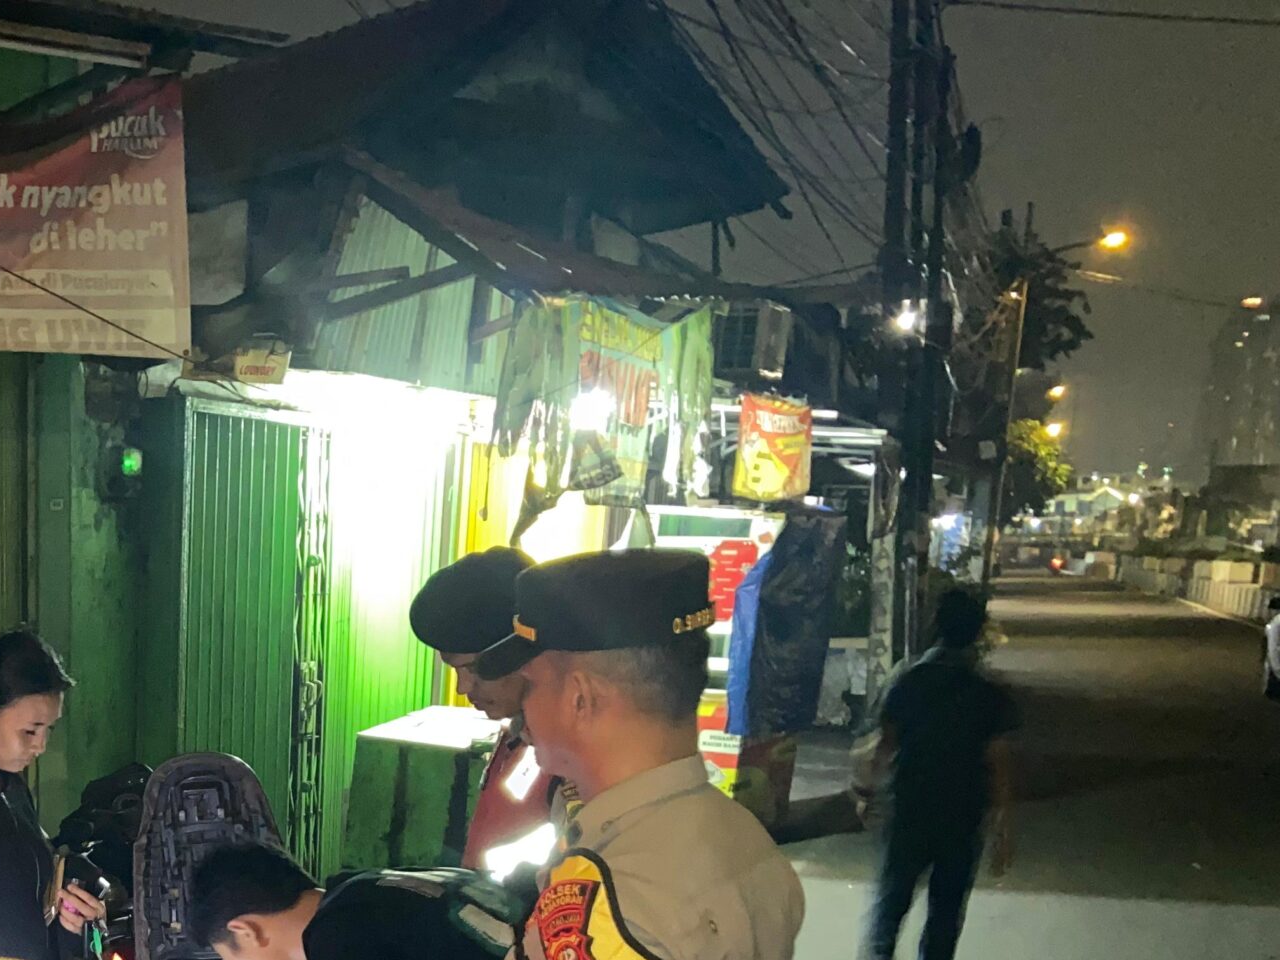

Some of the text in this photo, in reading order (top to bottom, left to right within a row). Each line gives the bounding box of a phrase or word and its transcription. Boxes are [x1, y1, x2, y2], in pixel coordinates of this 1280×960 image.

[90, 104, 167, 153] pucuk
[20, 173, 168, 217] nyangkut
[30, 221, 61, 254] di
